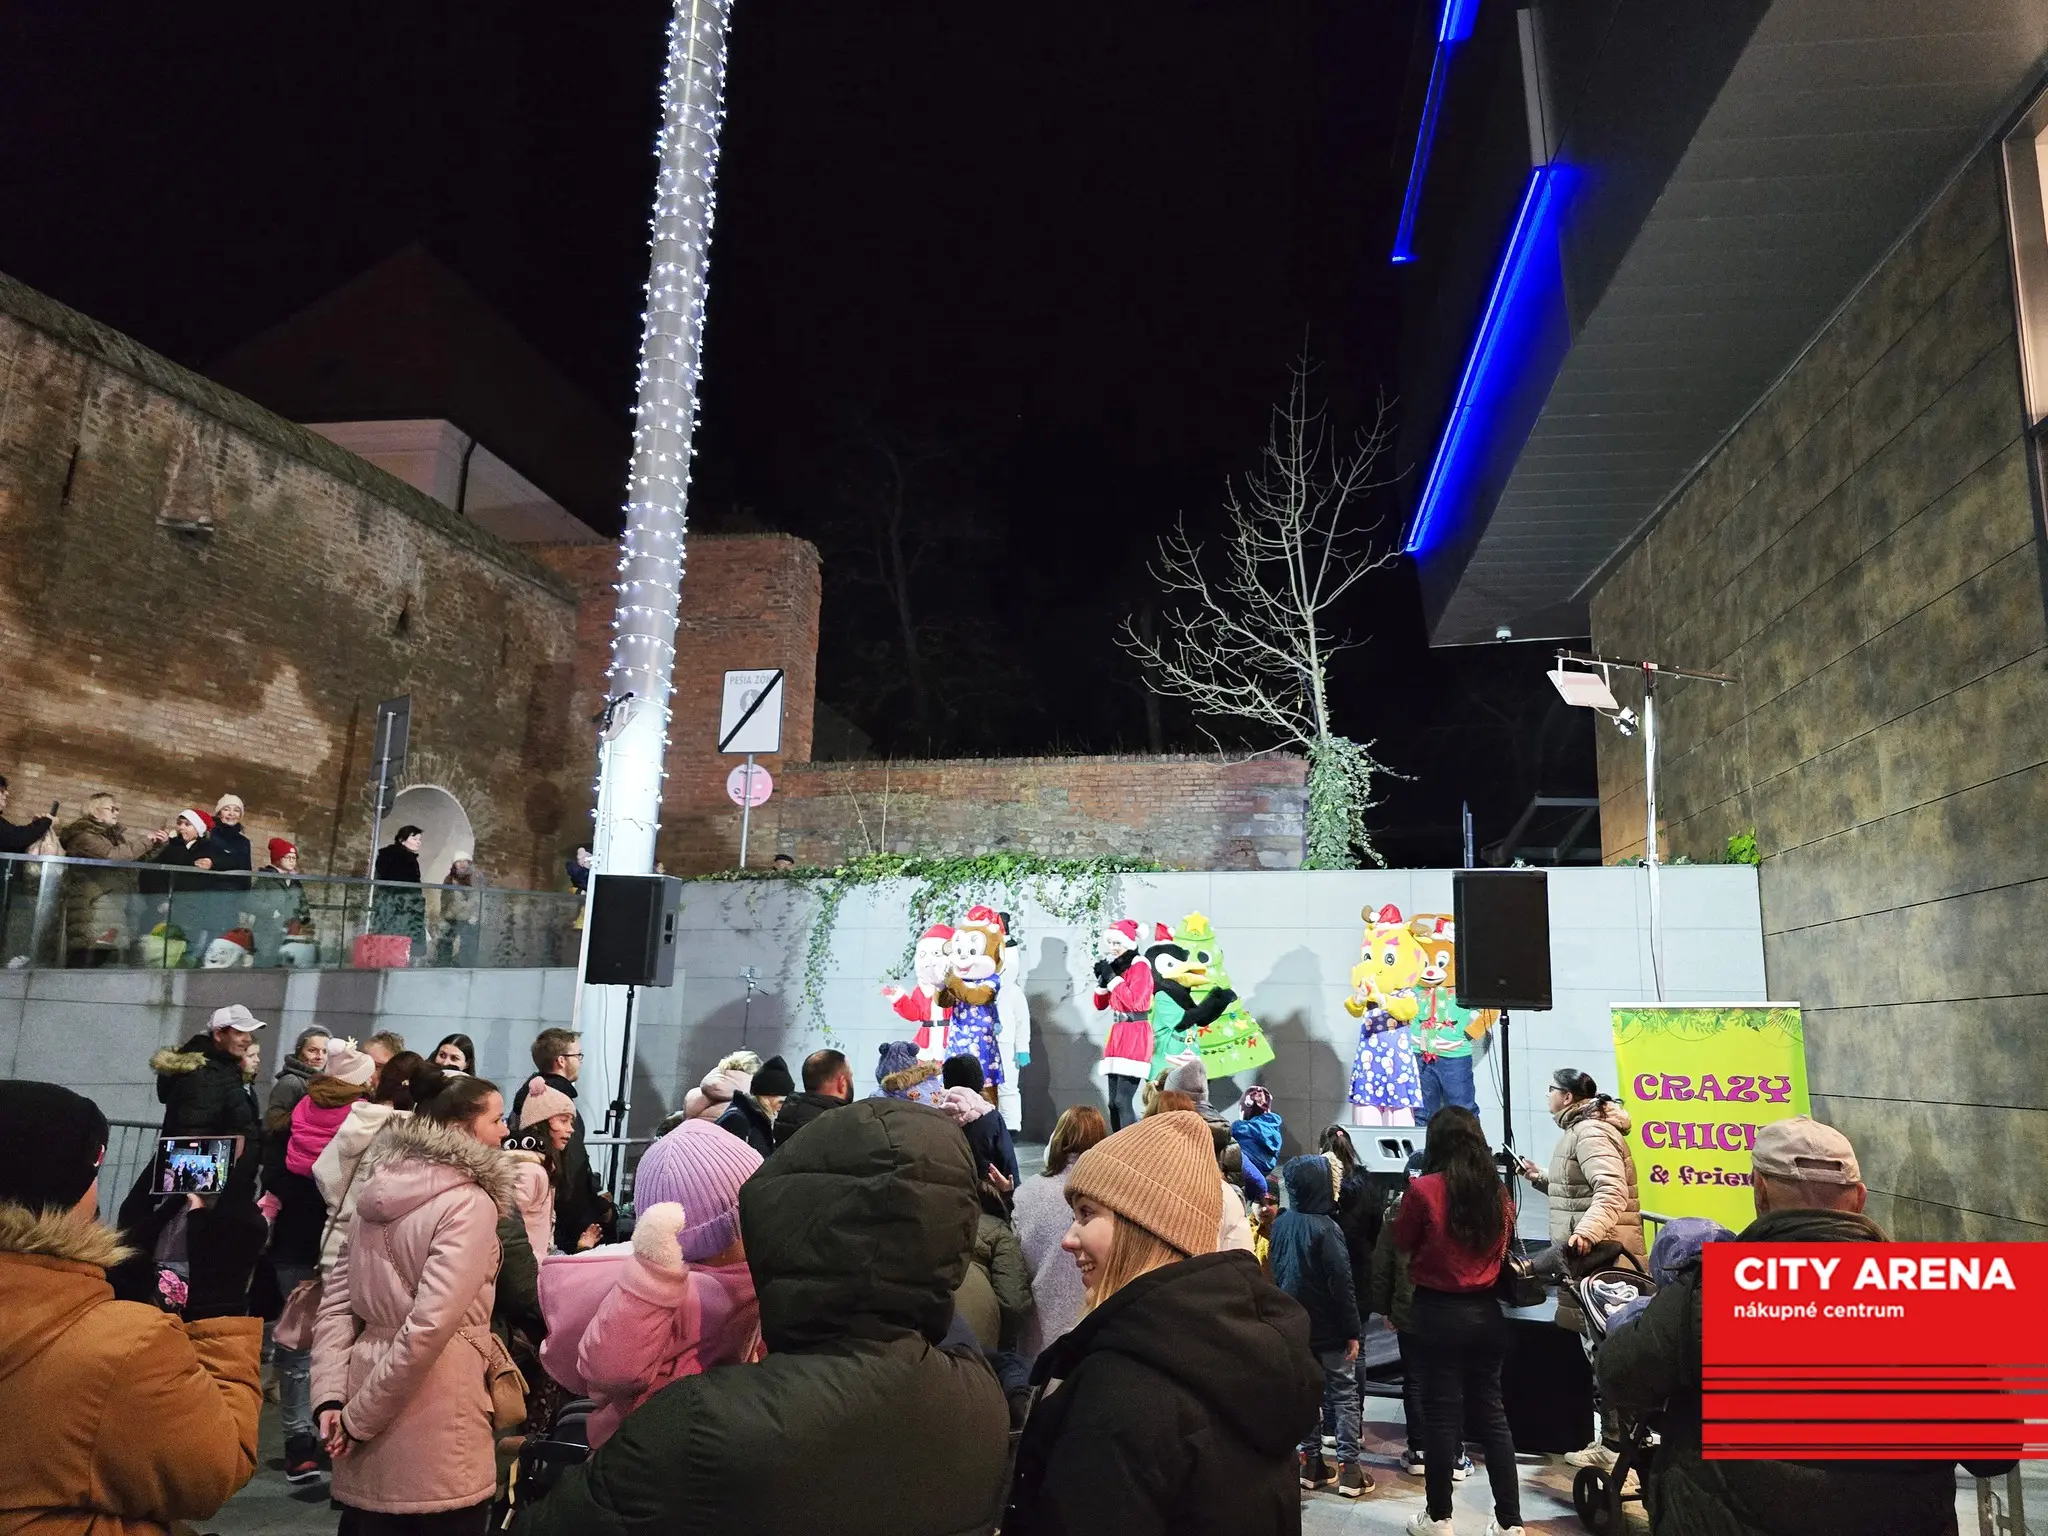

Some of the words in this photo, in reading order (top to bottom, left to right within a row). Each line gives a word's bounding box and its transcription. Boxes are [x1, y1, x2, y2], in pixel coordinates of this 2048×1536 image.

[754, 672, 773, 685] ZÓN
[1633, 1072, 1792, 1104] CRAZY
[1649, 1164, 1670, 1186] &
[1678, 1165, 1754, 1187] frien
